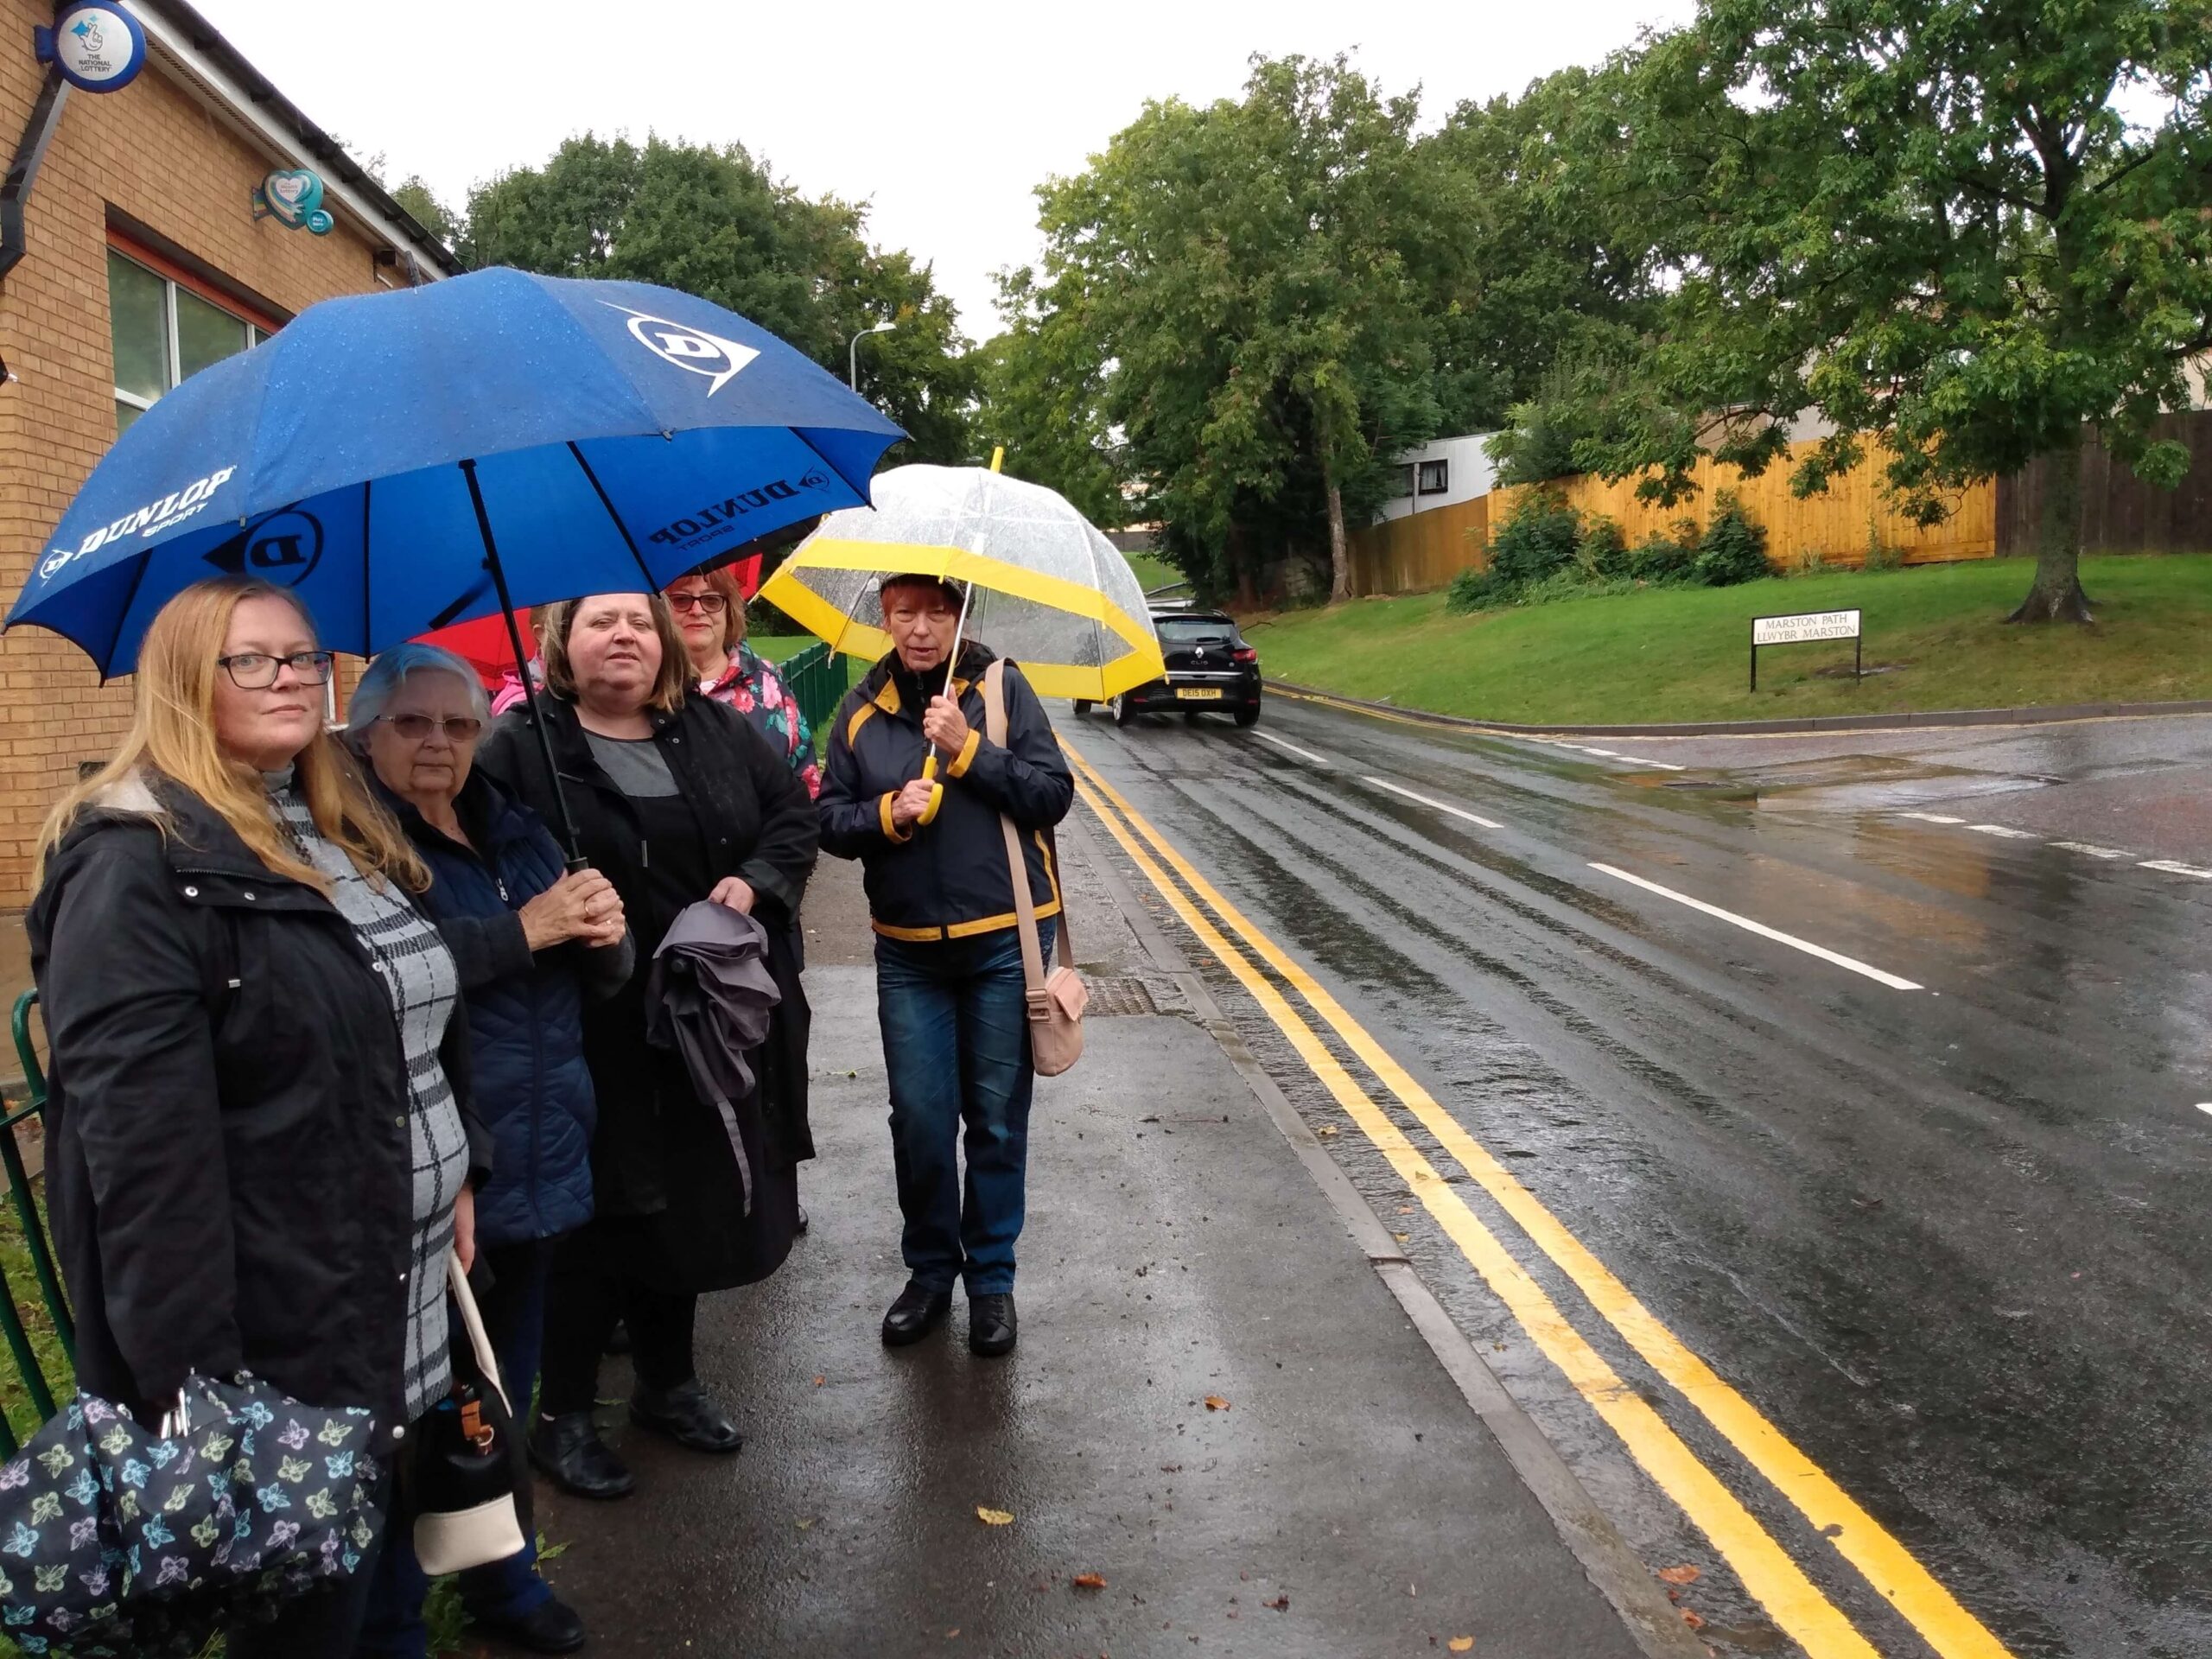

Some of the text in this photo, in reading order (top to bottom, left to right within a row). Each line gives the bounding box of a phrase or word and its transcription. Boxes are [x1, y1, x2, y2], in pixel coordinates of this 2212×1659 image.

[654, 332, 721, 359] D
[73, 467, 234, 561] DUNLOP
[142, 502, 208, 537] SPORT
[1757, 625, 1855, 642] LLWYBR MARSTON
[1765, 613, 1847, 630] MARSTON PATH
